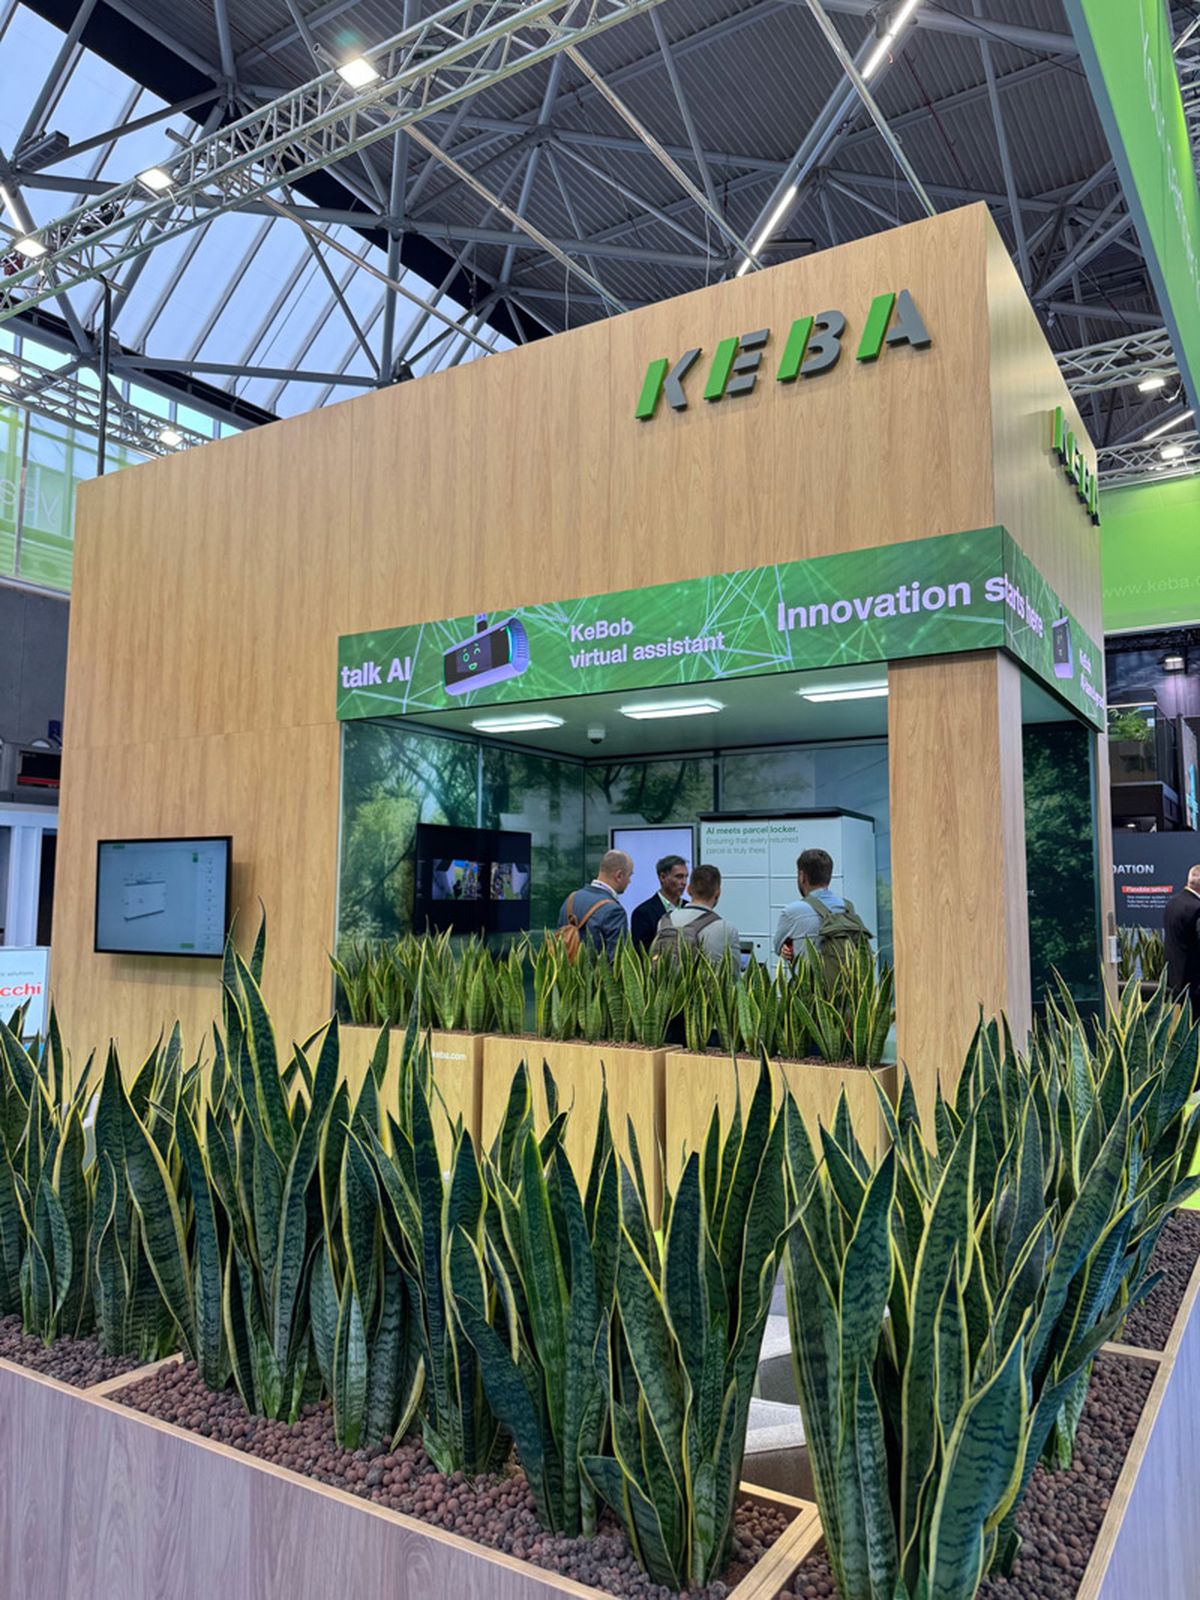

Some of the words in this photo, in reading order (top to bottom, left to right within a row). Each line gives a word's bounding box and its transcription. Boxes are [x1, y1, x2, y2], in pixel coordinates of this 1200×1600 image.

[635, 288, 932, 420] KEBA
[777, 581, 971, 631] Innovation
[570, 617, 632, 643] KeBob
[570, 644, 628, 669] virtual
[632, 634, 726, 661] assistant
[341, 662, 381, 688] talk
[387, 657, 411, 681] AI
[742, 826, 769, 835] parcel
[770, 825, 799, 833] locker.
